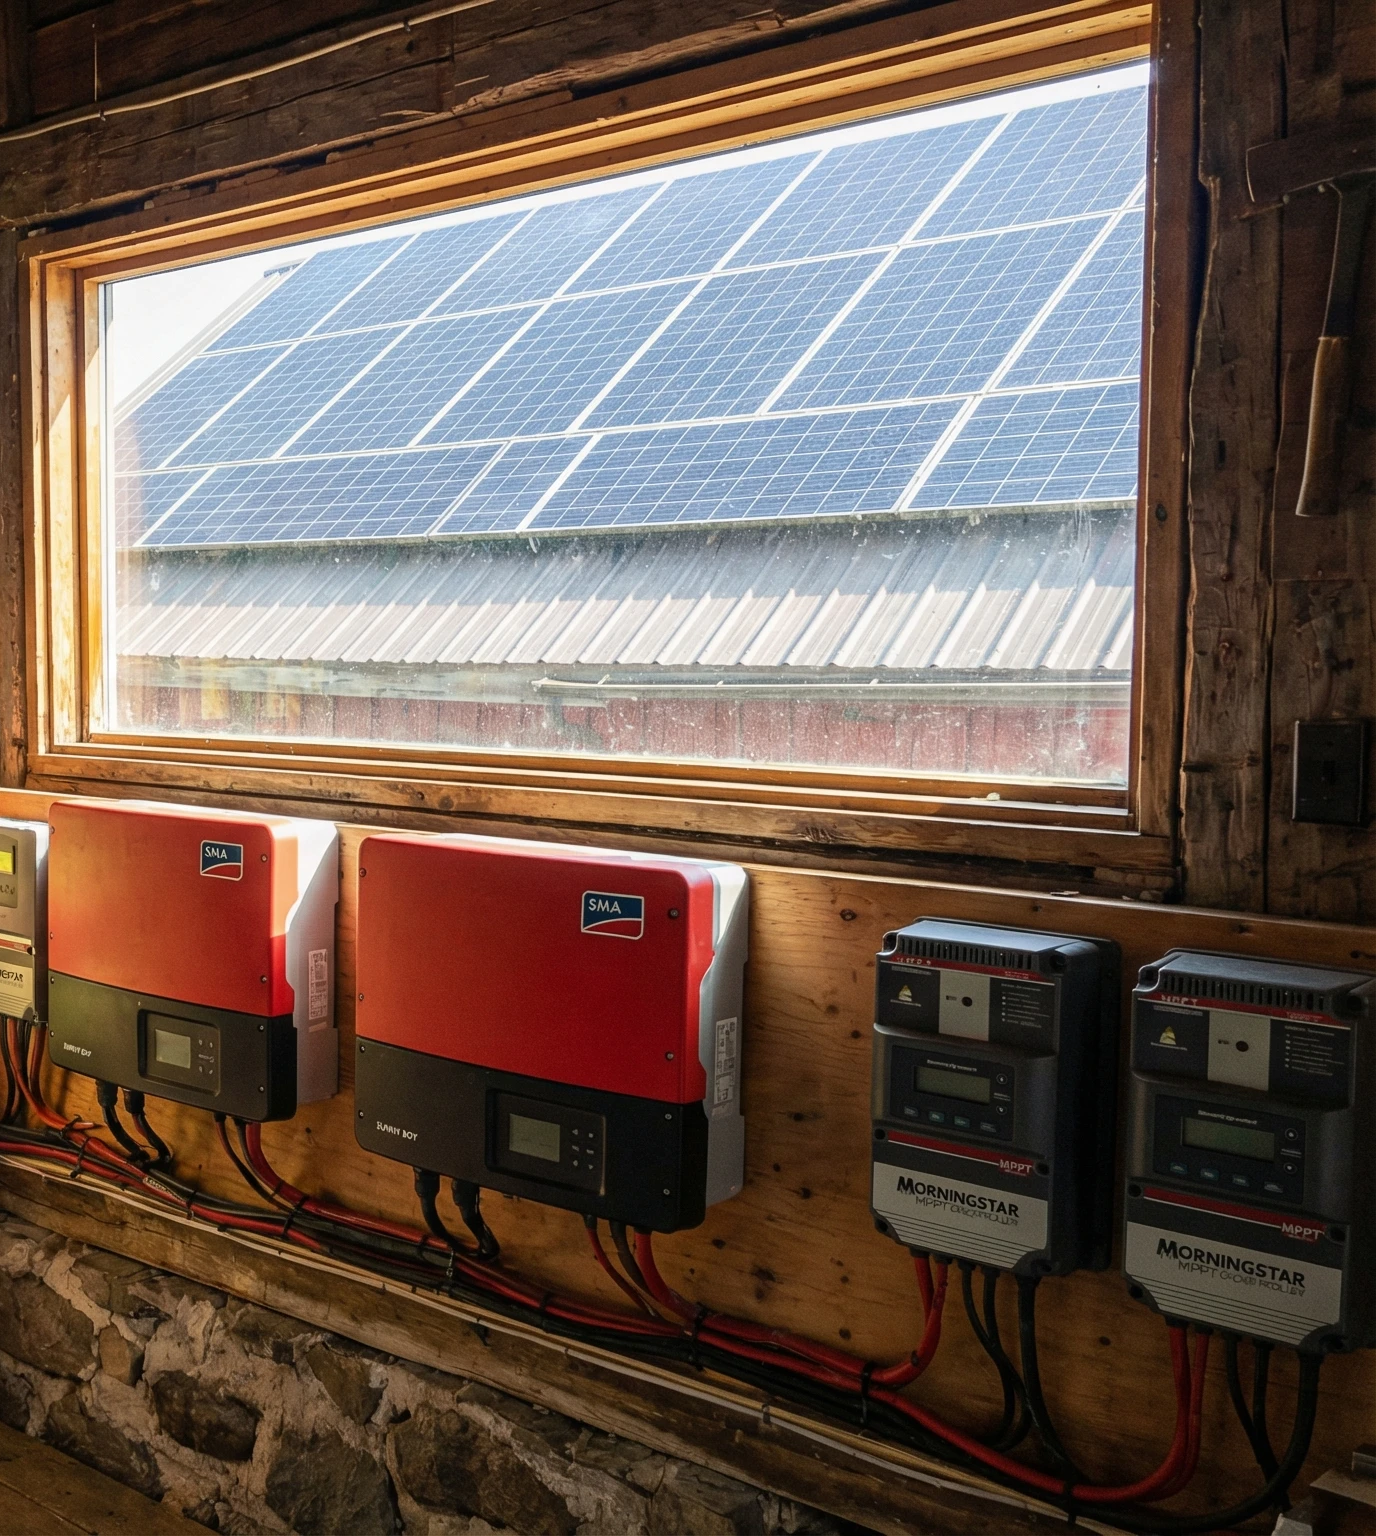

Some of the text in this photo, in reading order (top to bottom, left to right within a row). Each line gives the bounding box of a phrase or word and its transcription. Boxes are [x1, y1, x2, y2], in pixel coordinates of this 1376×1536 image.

[205, 846, 228, 860] SMA
[588, 898, 622, 914] SMA
[999, 1158, 1033, 1174] MPPT
[897, 1175, 1020, 1218] MORNINGSTAR
[1281, 1221, 1321, 1241] MPPT
[1156, 1238, 1306, 1289] MORNINGSTAR
